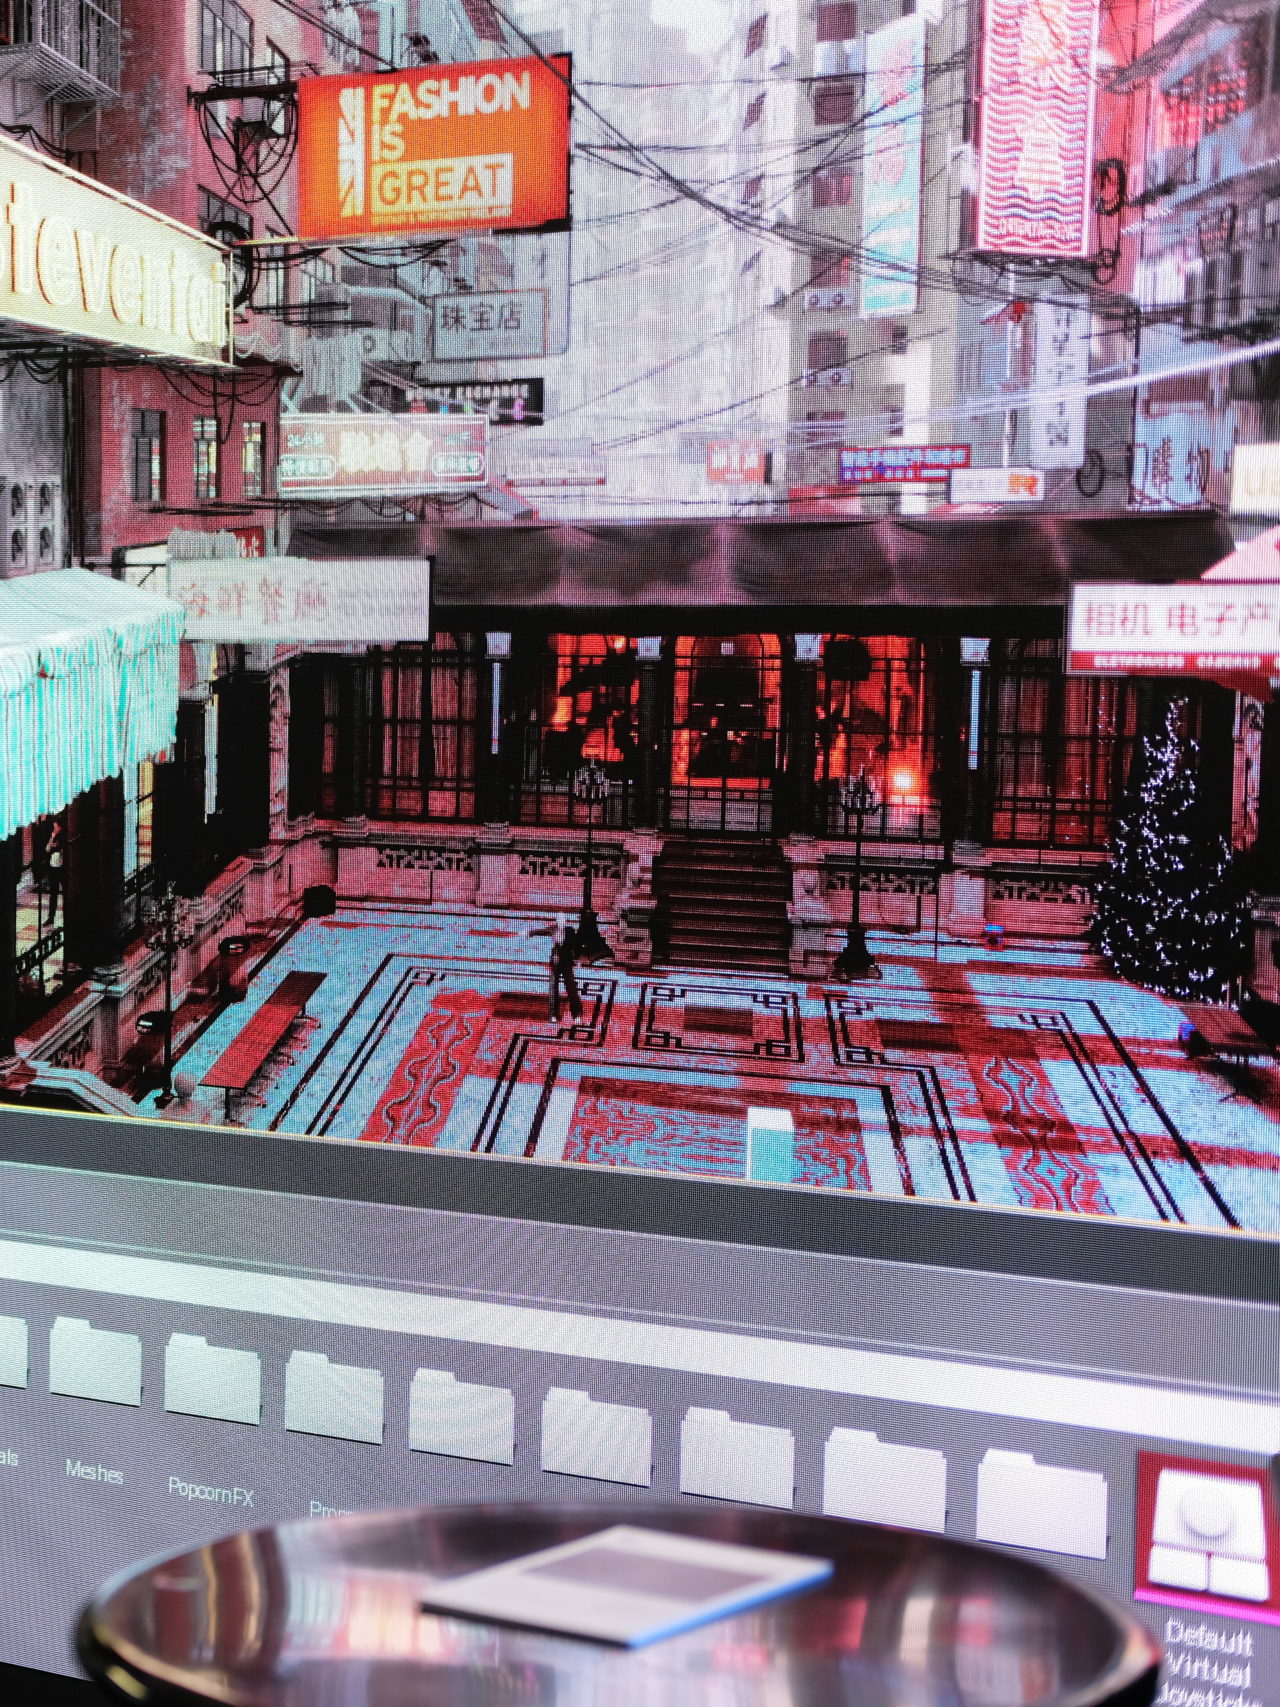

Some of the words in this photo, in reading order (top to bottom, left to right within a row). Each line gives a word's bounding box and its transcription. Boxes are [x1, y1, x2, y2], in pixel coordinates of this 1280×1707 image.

[371, 71, 532, 124] FASHION
[371, 123, 406, 162] IS
[378, 162, 505, 206] GREAT
[441, 299, 523, 334] 珠宝店
[1084, 601, 1151, 637] 相机
[1167, 601, 1280, 637] 电子产
[66, 1458, 124, 1487] Meshes
[167, 1475, 256, 1509] PopcornFX
[1165, 1617, 1254, 1659] Default
[1165, 1650, 1252, 1690] Virtual
